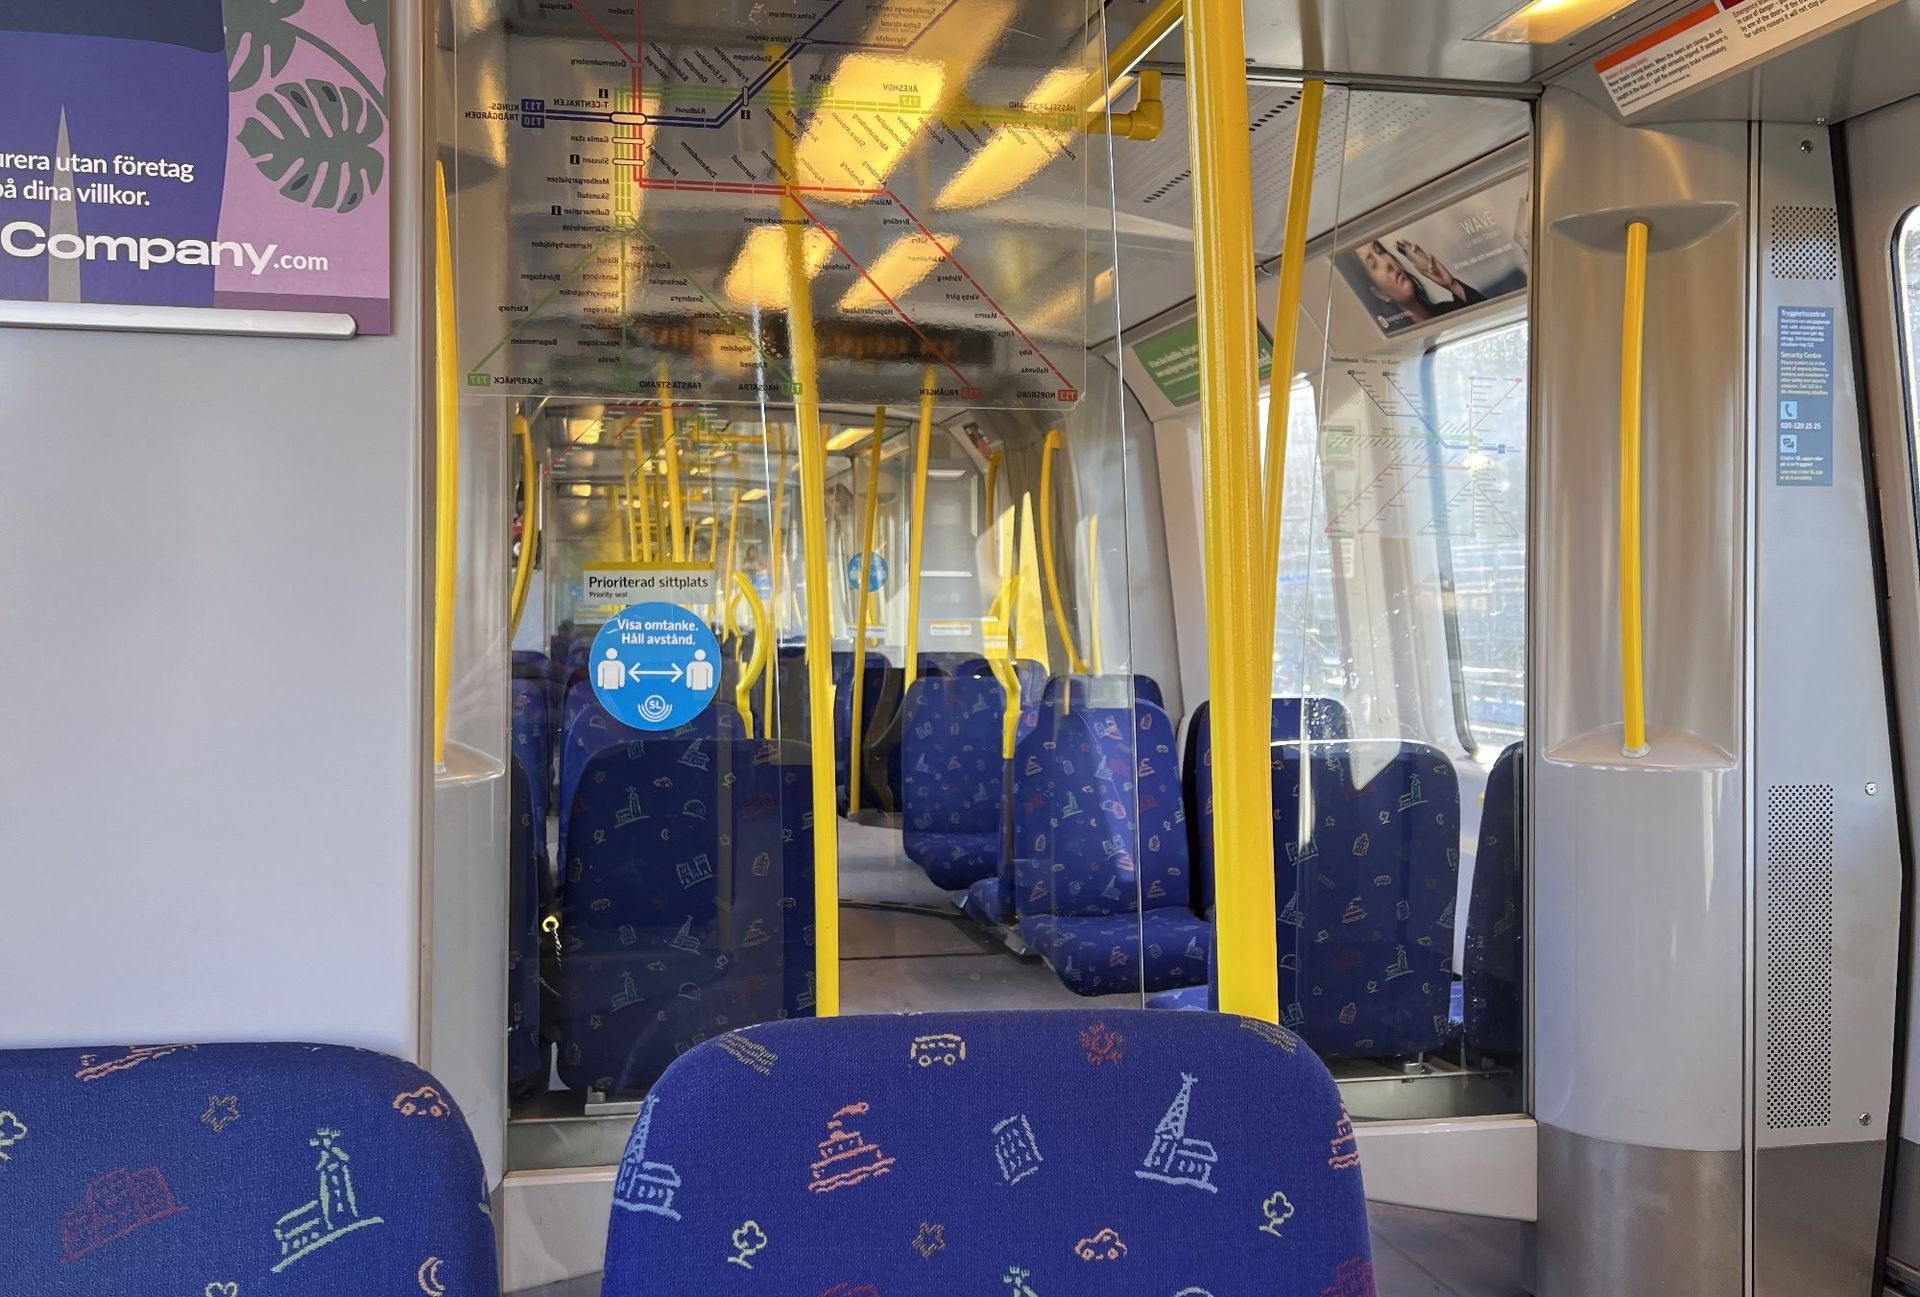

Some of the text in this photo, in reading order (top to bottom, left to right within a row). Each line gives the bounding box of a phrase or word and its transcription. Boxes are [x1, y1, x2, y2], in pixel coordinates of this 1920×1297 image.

[56, 153, 107, 174] utan
[113, 154, 195, 183] företag
[23, 179, 72, 201] dina
[76, 182, 150, 206] villkor.
[589, 576, 709, 590] Prioriterad sittplats
[589, 591, 613, 599] Priority
[617, 619, 699, 632] Visa omtanke.
[621, 632, 696, 646] Håll avstånd.
[649, 700, 662, 710] SL
